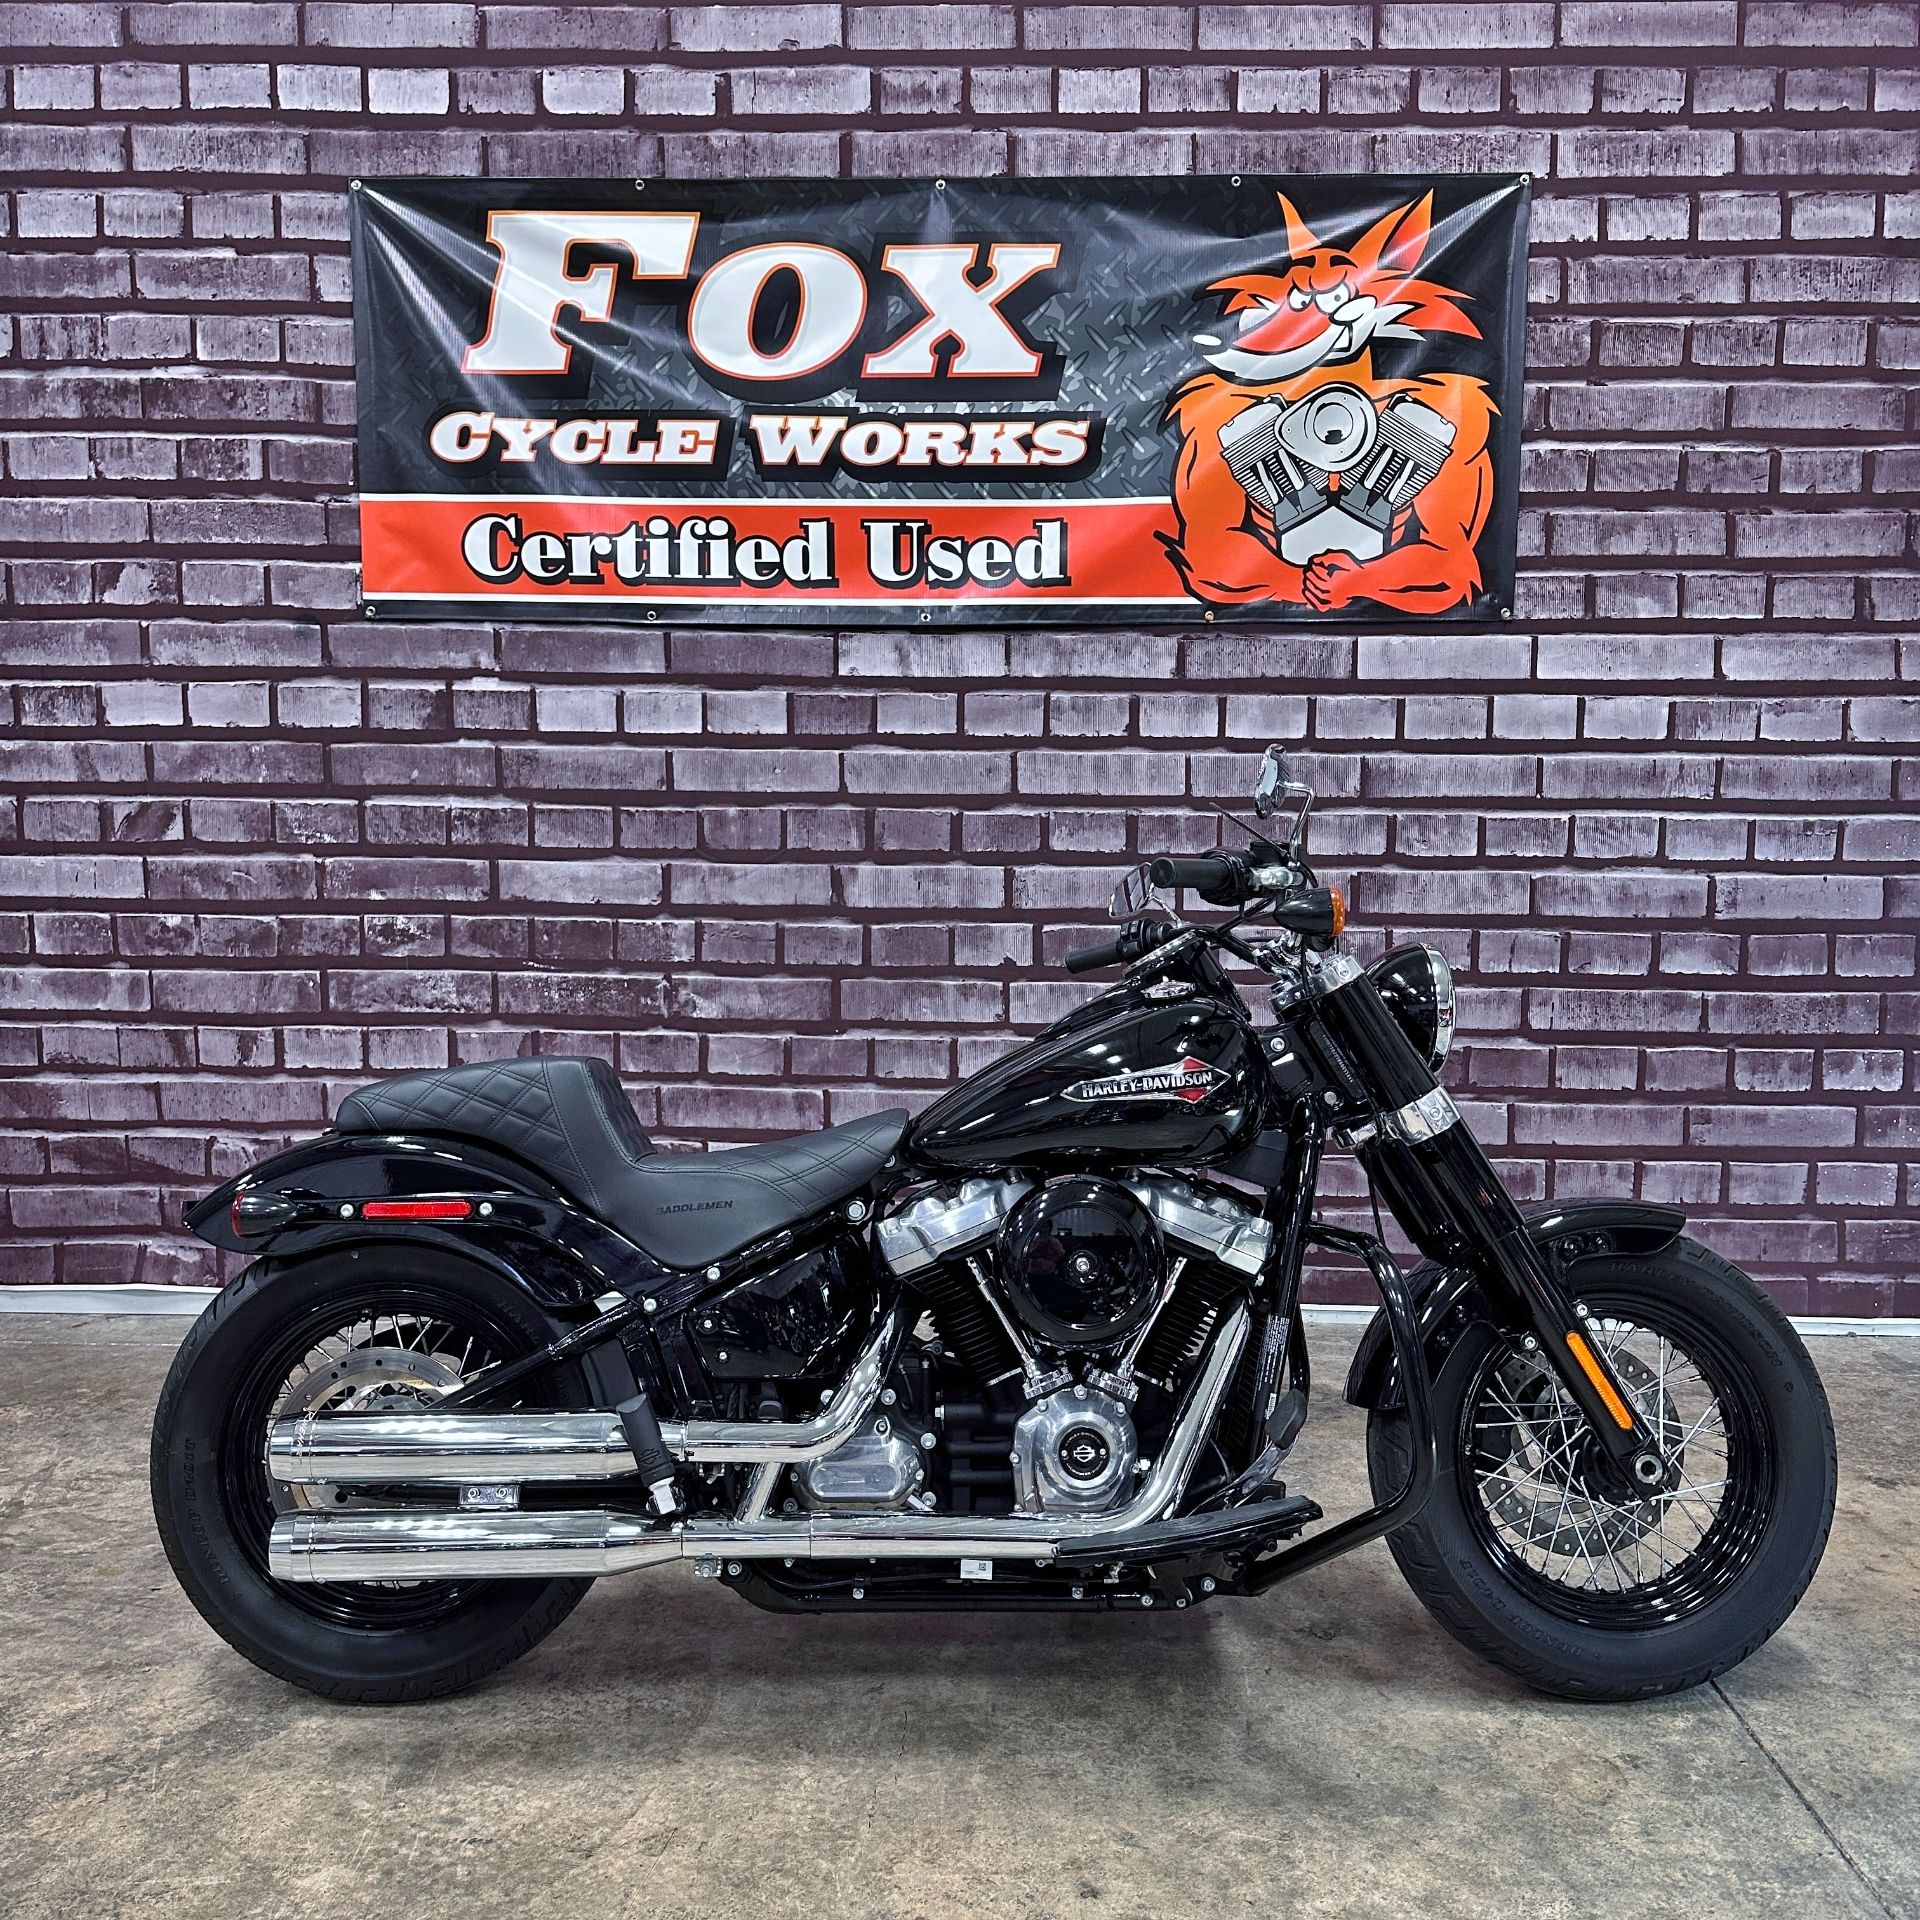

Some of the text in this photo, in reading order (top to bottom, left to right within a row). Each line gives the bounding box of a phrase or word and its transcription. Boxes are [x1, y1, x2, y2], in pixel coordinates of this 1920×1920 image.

[430, 411, 1089, 467] CYCLE WORKS
[463, 515, 1067, 583] Certified Used
[1081, 1071, 1213, 1098] HARLEY-DAVIDSON
[655, 1200, 734, 1216] SADDLEMEN
